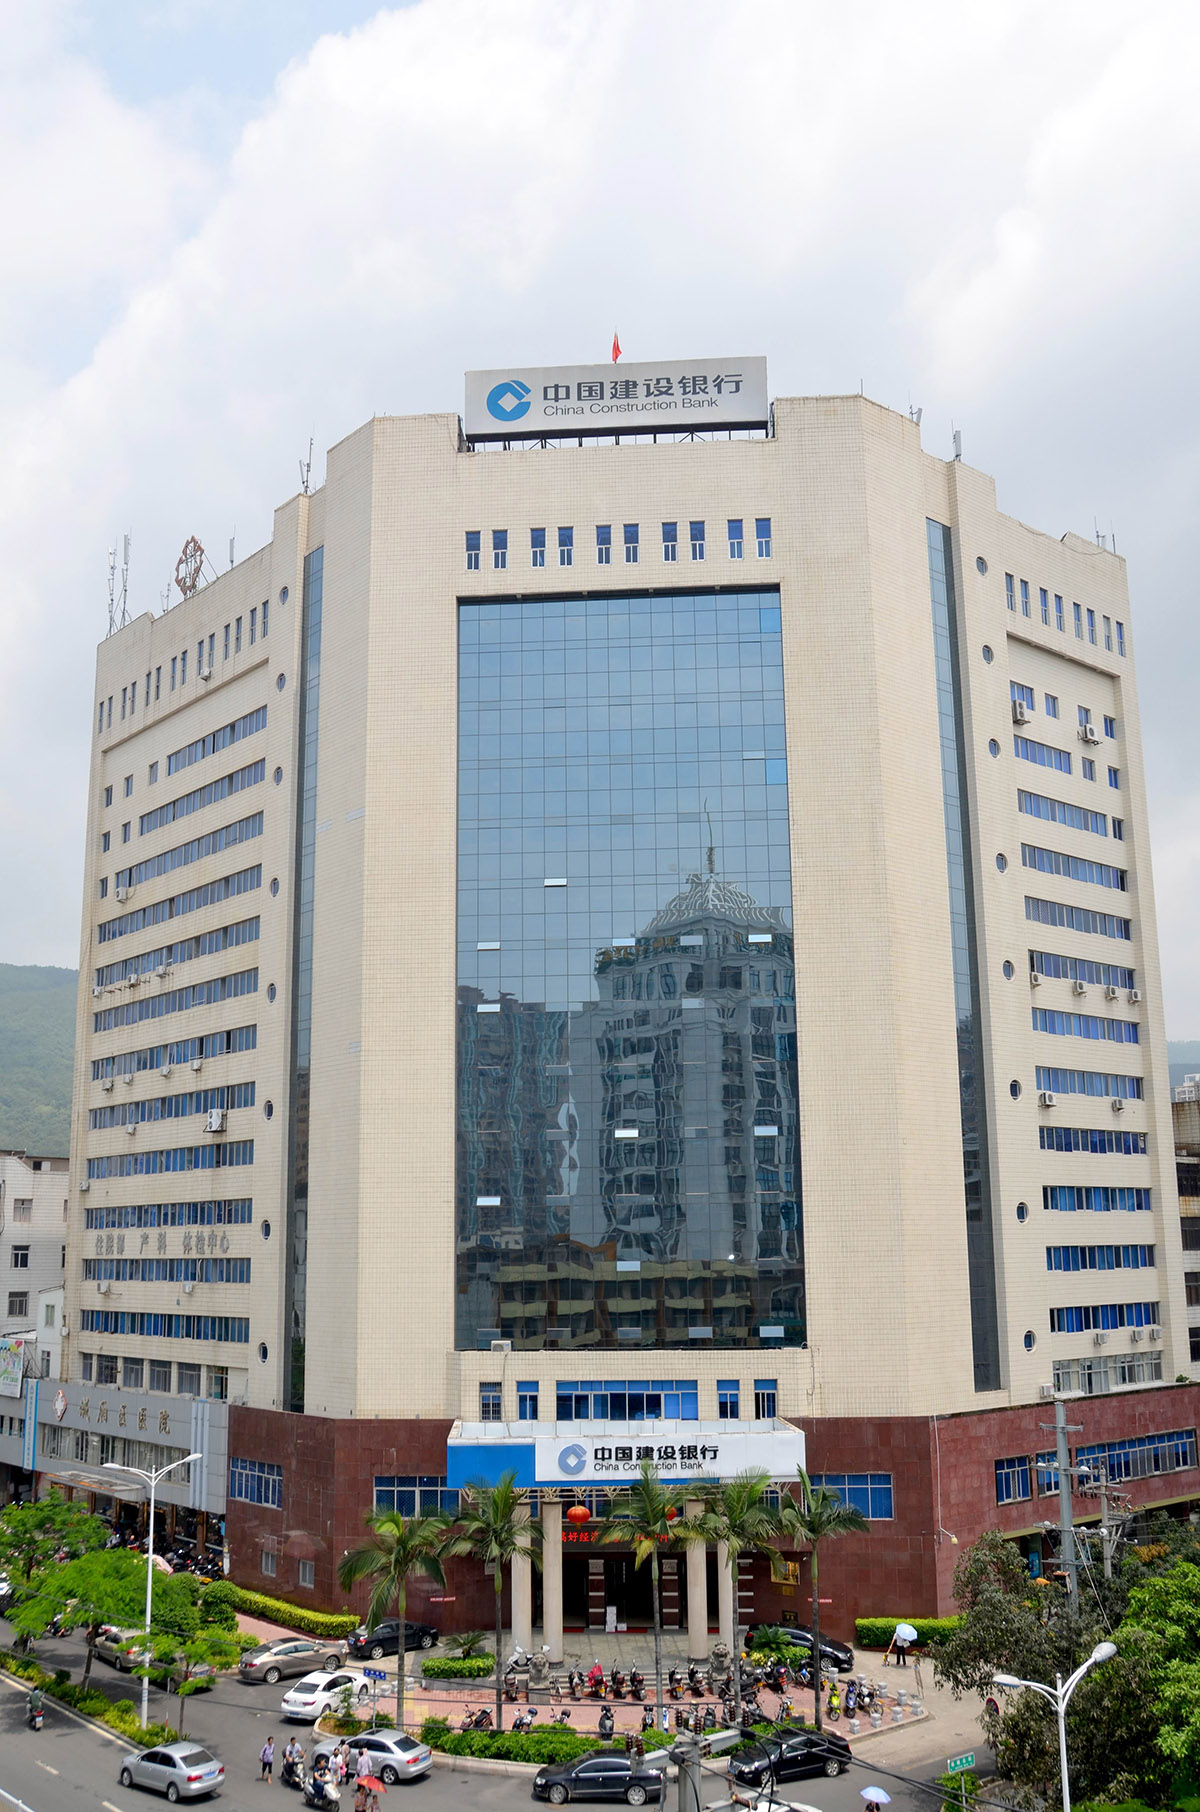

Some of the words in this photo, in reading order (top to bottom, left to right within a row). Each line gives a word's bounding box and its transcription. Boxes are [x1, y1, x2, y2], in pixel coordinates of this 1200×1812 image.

[543, 374, 743, 402] 中国建设银行
[543, 404, 585, 417] China
[589, 400, 677, 414] Construction
[682, 397, 719, 409] Bank
[594, 1444, 719, 1462] 中国建设银行
[594, 1463, 619, 1471] China
[680, 1460, 704, 1470] Bank
